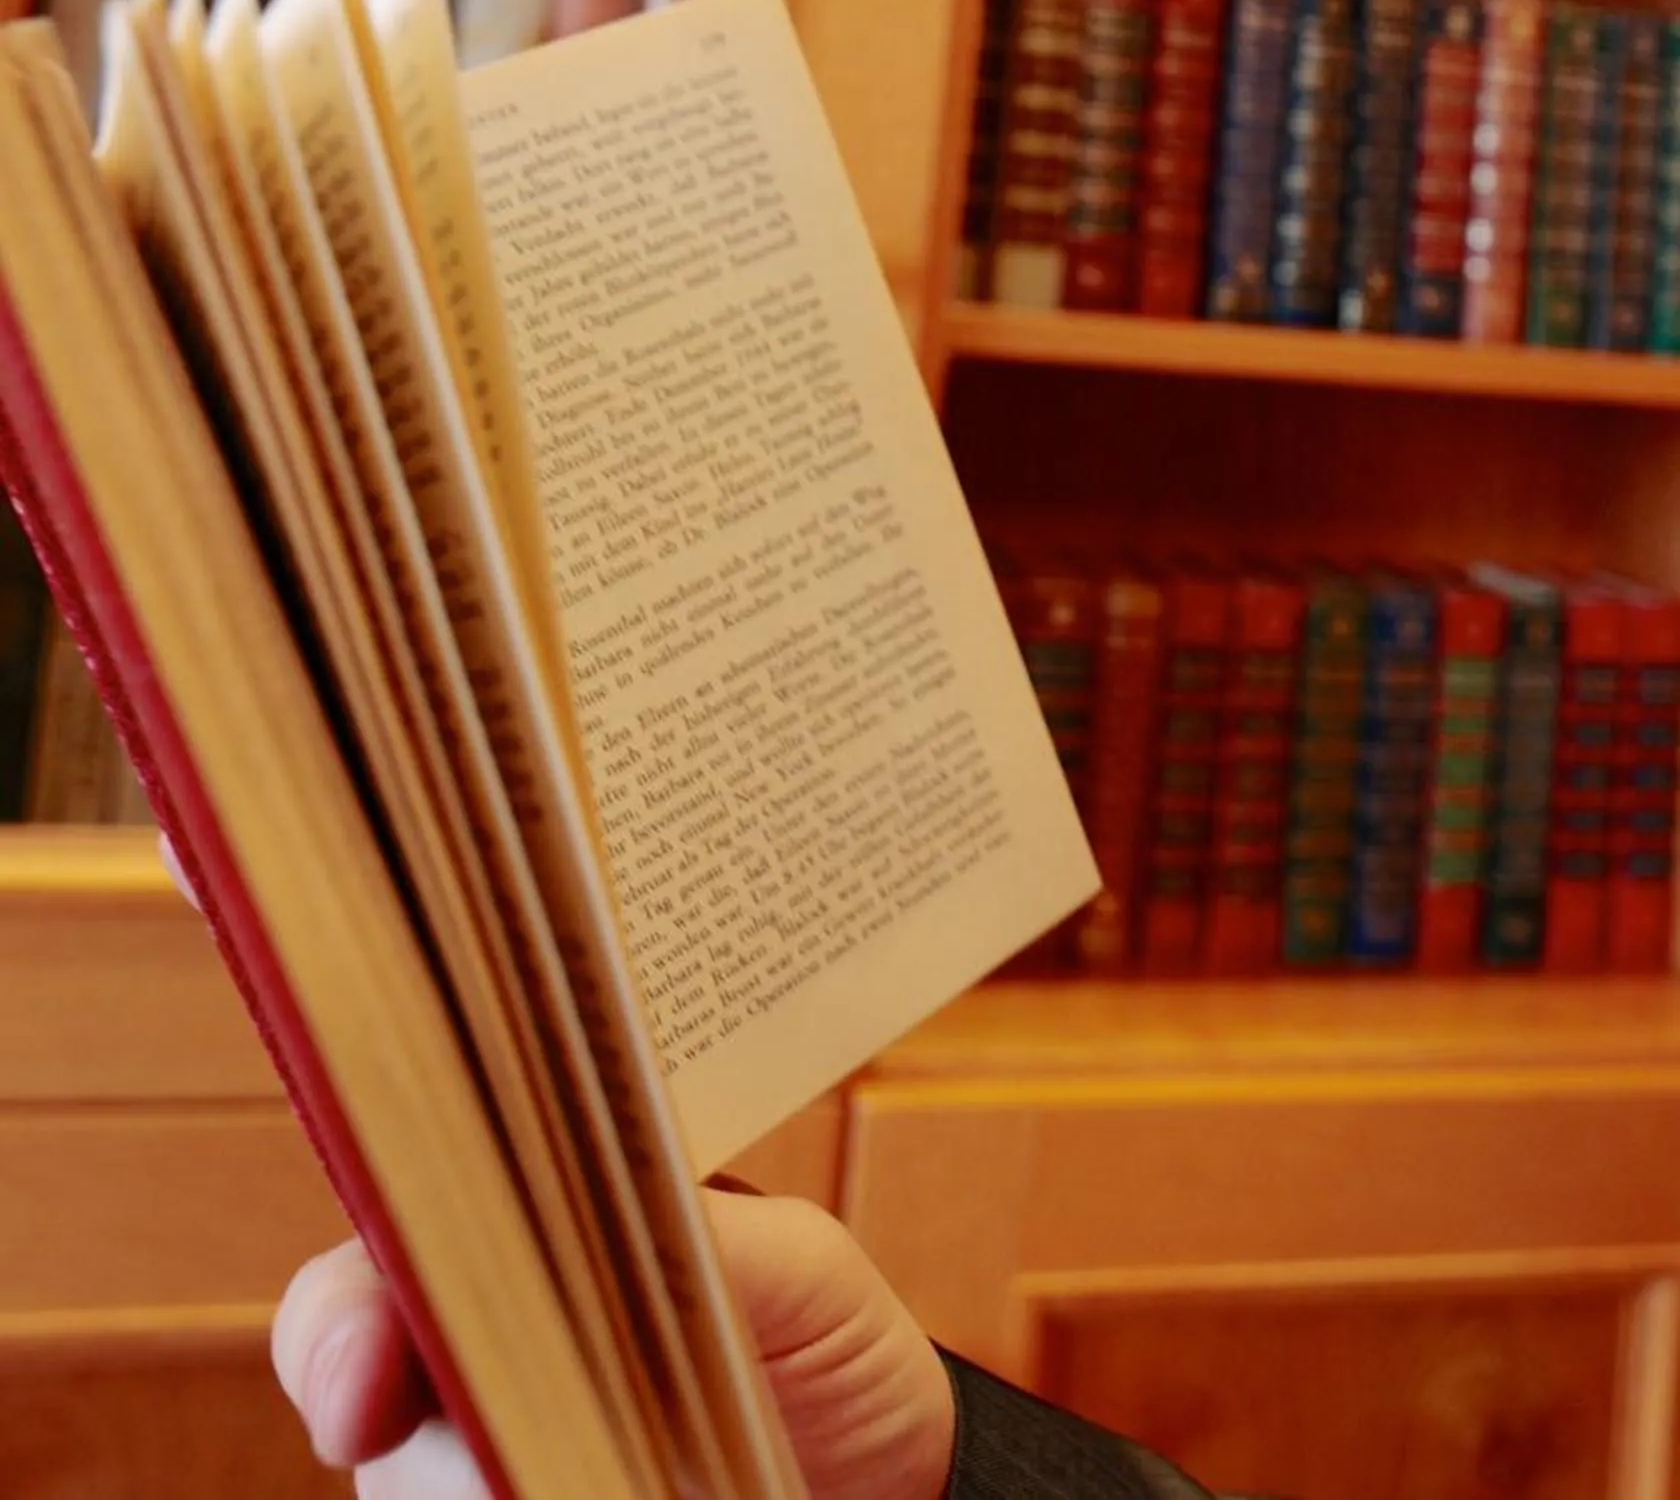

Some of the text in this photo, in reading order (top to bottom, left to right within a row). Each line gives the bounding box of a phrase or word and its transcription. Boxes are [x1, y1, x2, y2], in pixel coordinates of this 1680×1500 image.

[641, 508, 680, 542] Kind
[600, 727, 631, 753] den
[605, 744, 641, 779] nach
[643, 766, 703, 812] Barbara
[635, 835, 672, 872] noch
[678, 800, 729, 845] einmal
[734, 780, 769, 810] New
[704, 831, 731, 856] Tag
[643, 896, 672, 923] Tag
[679, 863, 723, 905] genau
[708, 939, 732, 964] lag
[670, 984, 704, 1017] dem
